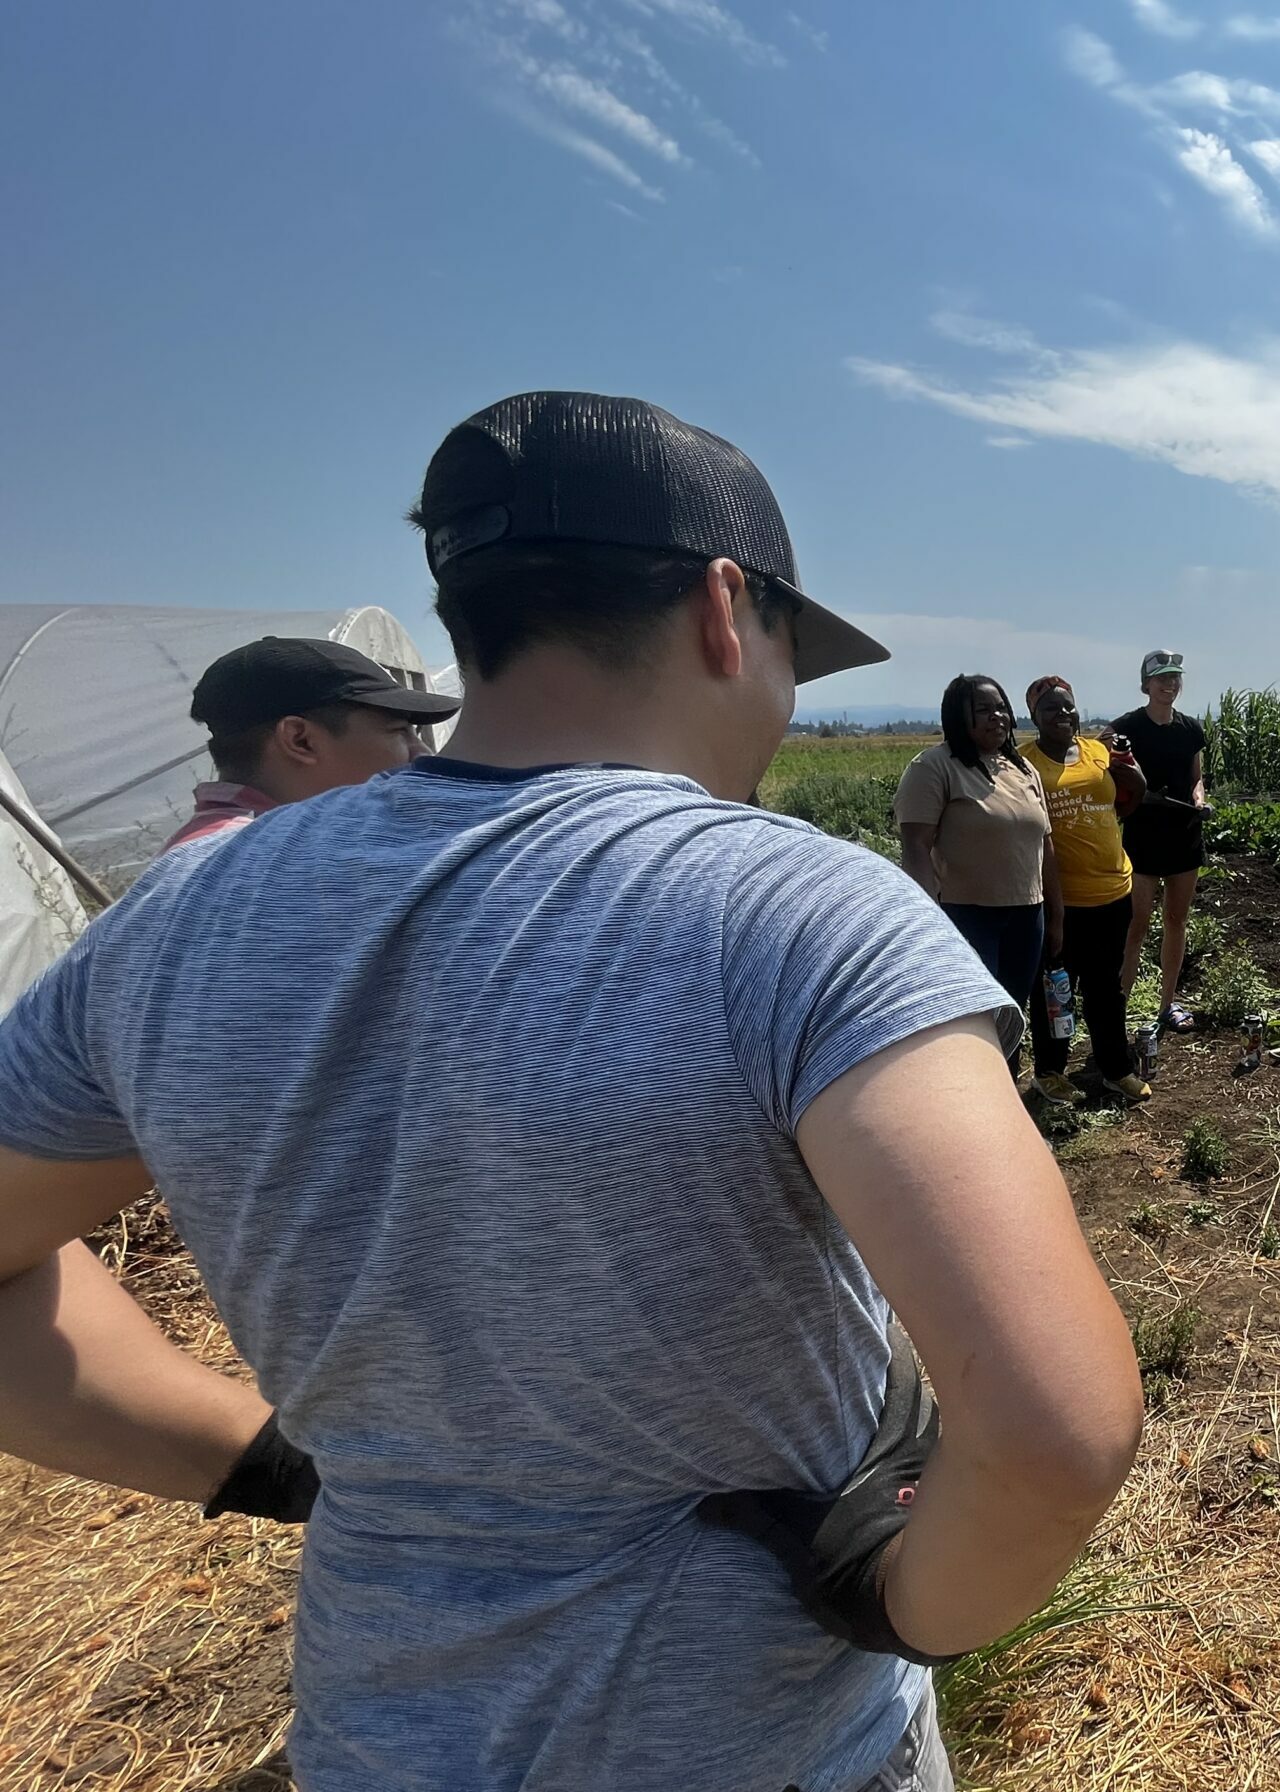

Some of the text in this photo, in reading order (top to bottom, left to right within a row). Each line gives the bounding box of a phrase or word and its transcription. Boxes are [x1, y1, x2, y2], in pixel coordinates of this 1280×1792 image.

[1045, 788, 1071, 800] lack
[1048, 794, 1093, 809] lessed &
[1051, 807, 1079, 818] ighly
